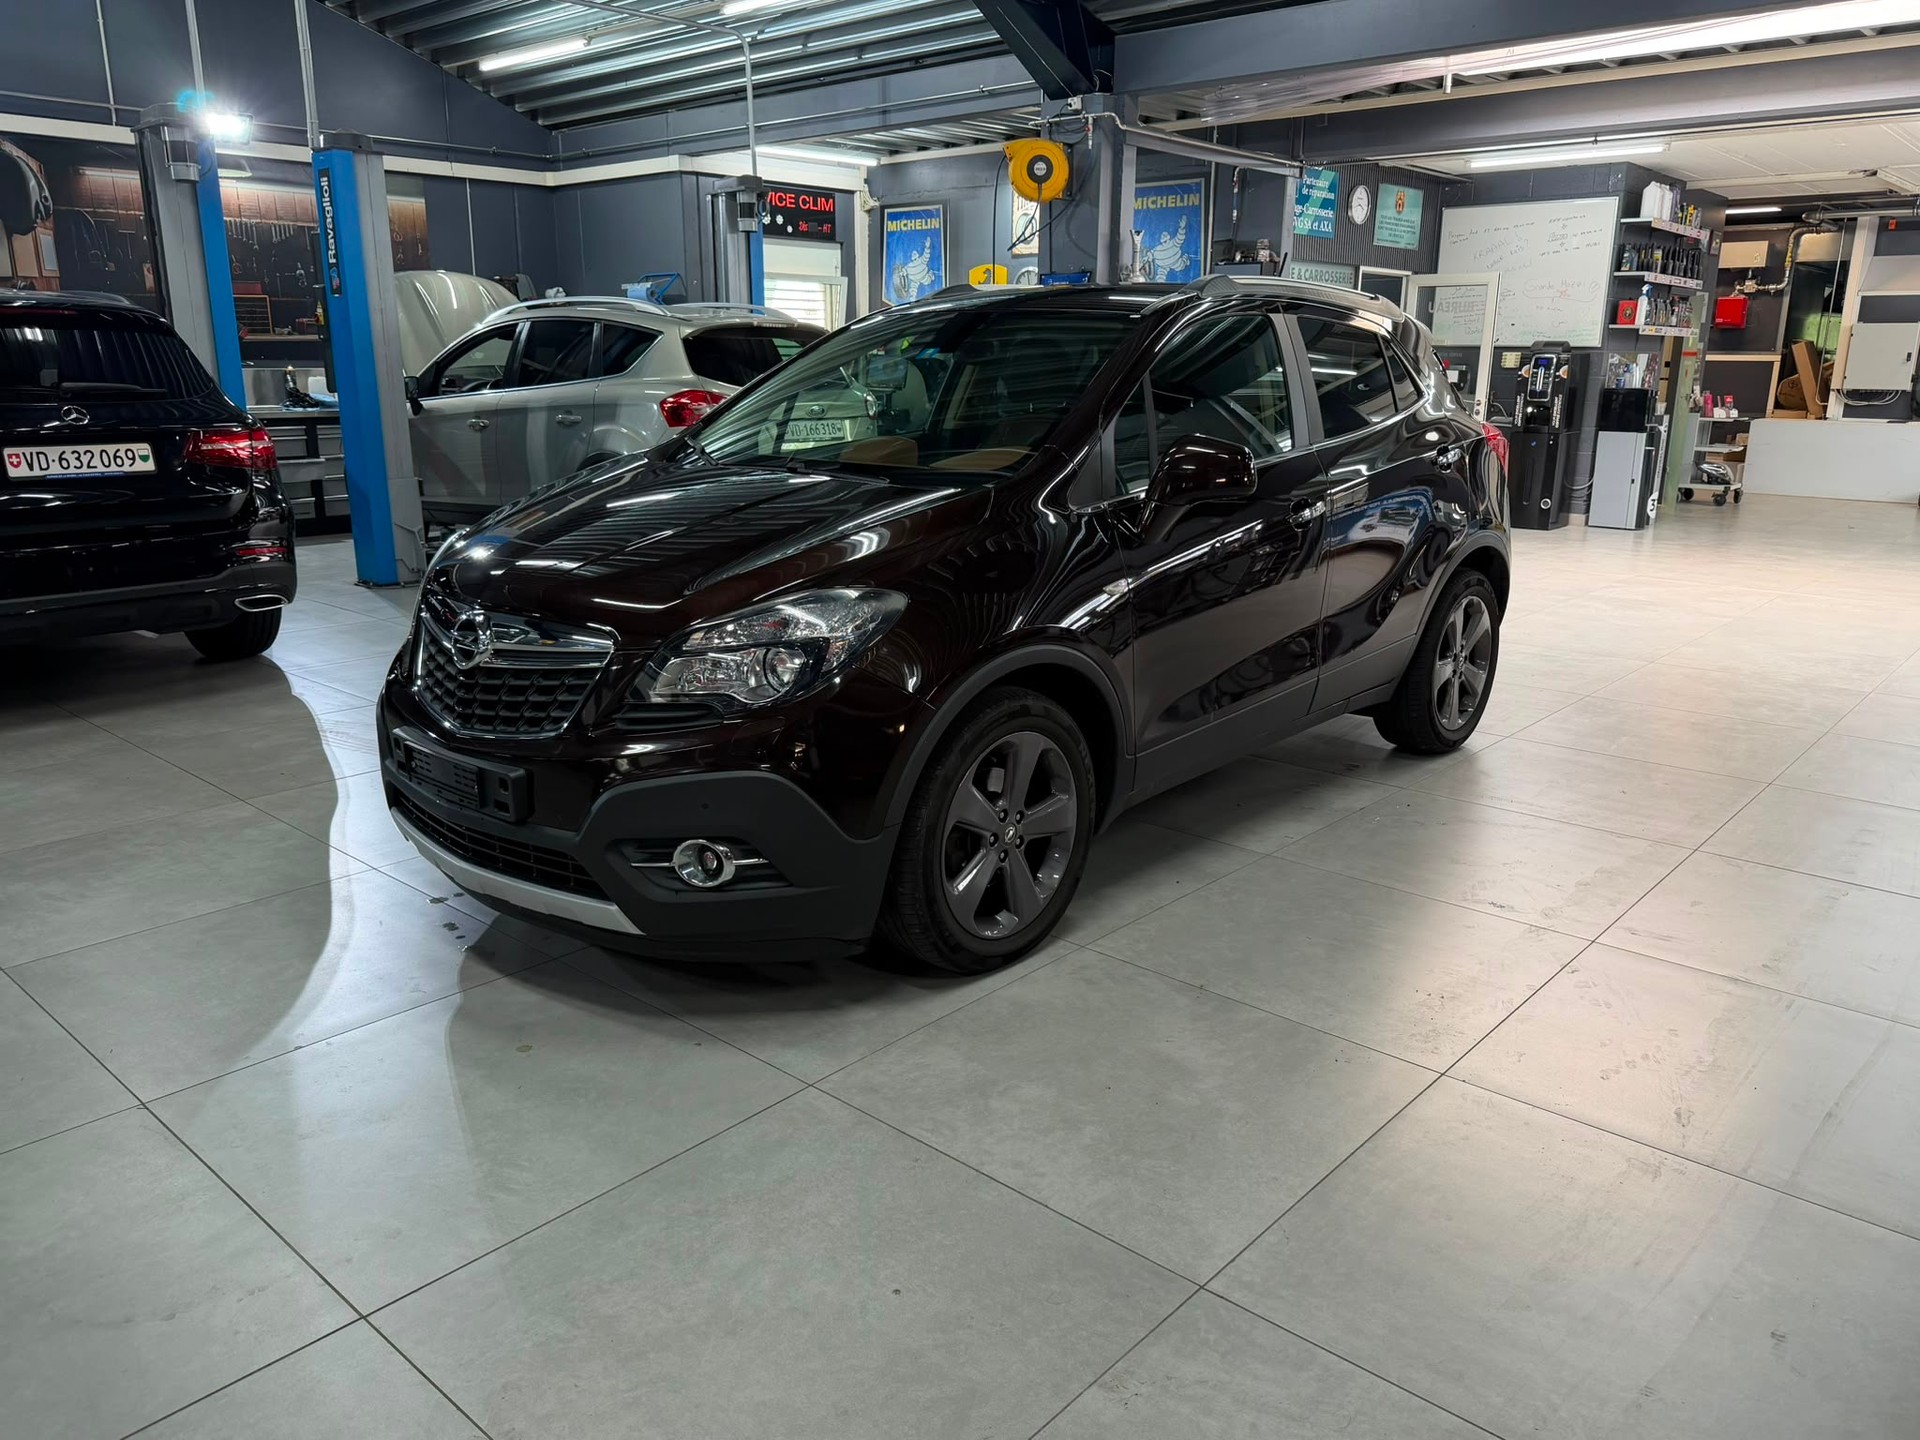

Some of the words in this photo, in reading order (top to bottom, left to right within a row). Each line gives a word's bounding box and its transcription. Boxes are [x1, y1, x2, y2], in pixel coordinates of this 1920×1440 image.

[1302, 185, 1309, 195] de
[799, 195, 834, 212] CLIM
[1135, 193, 1200, 210] MICHELIN
[1294, 203, 1334, 218] ge-Carrosserie
[320, 176, 337, 264] Ravaglioli
[887, 217, 940, 232] MICHELIN
[1319, 220, 1333, 233] AXA
[1303, 268, 1354, 285] CARROSSERIE
